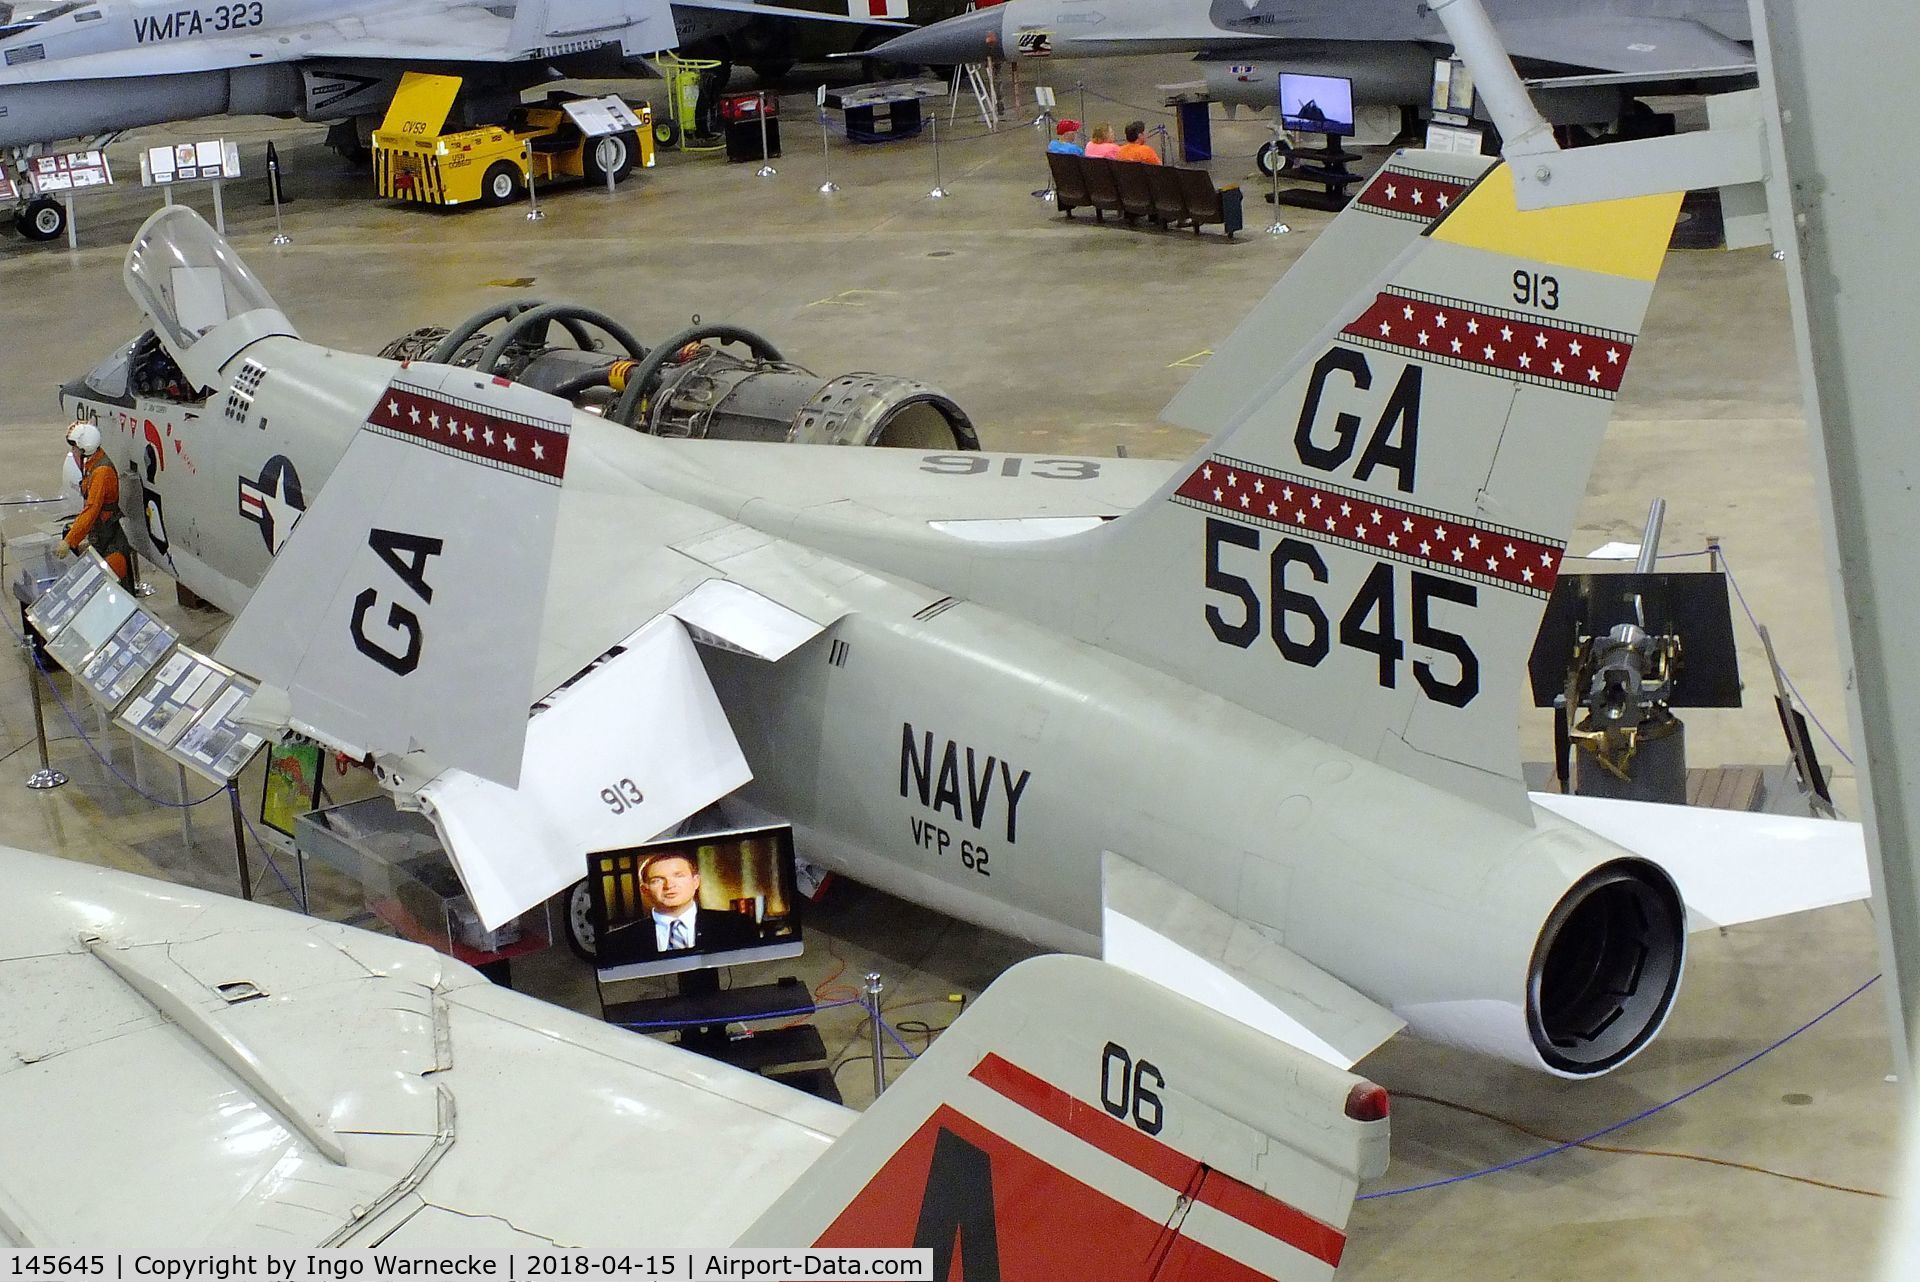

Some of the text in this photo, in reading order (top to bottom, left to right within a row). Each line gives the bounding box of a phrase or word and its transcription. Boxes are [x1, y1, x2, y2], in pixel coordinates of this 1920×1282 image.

[133, 2, 264, 44] VMFA-323
[402, 120, 427, 135] CV59
[1512, 268, 1560, 311] 913
[1293, 346, 1423, 494] GA
[919, 454, 1101, 481] 913
[349, 528, 444, 677] GA
[1204, 516, 1480, 709] 5645
[600, 777, 645, 815] 913
[899, 722, 1031, 845] NAVY
[910, 815, 991, 877] VFP 62
[1100, 1041, 1166, 1137] 06
